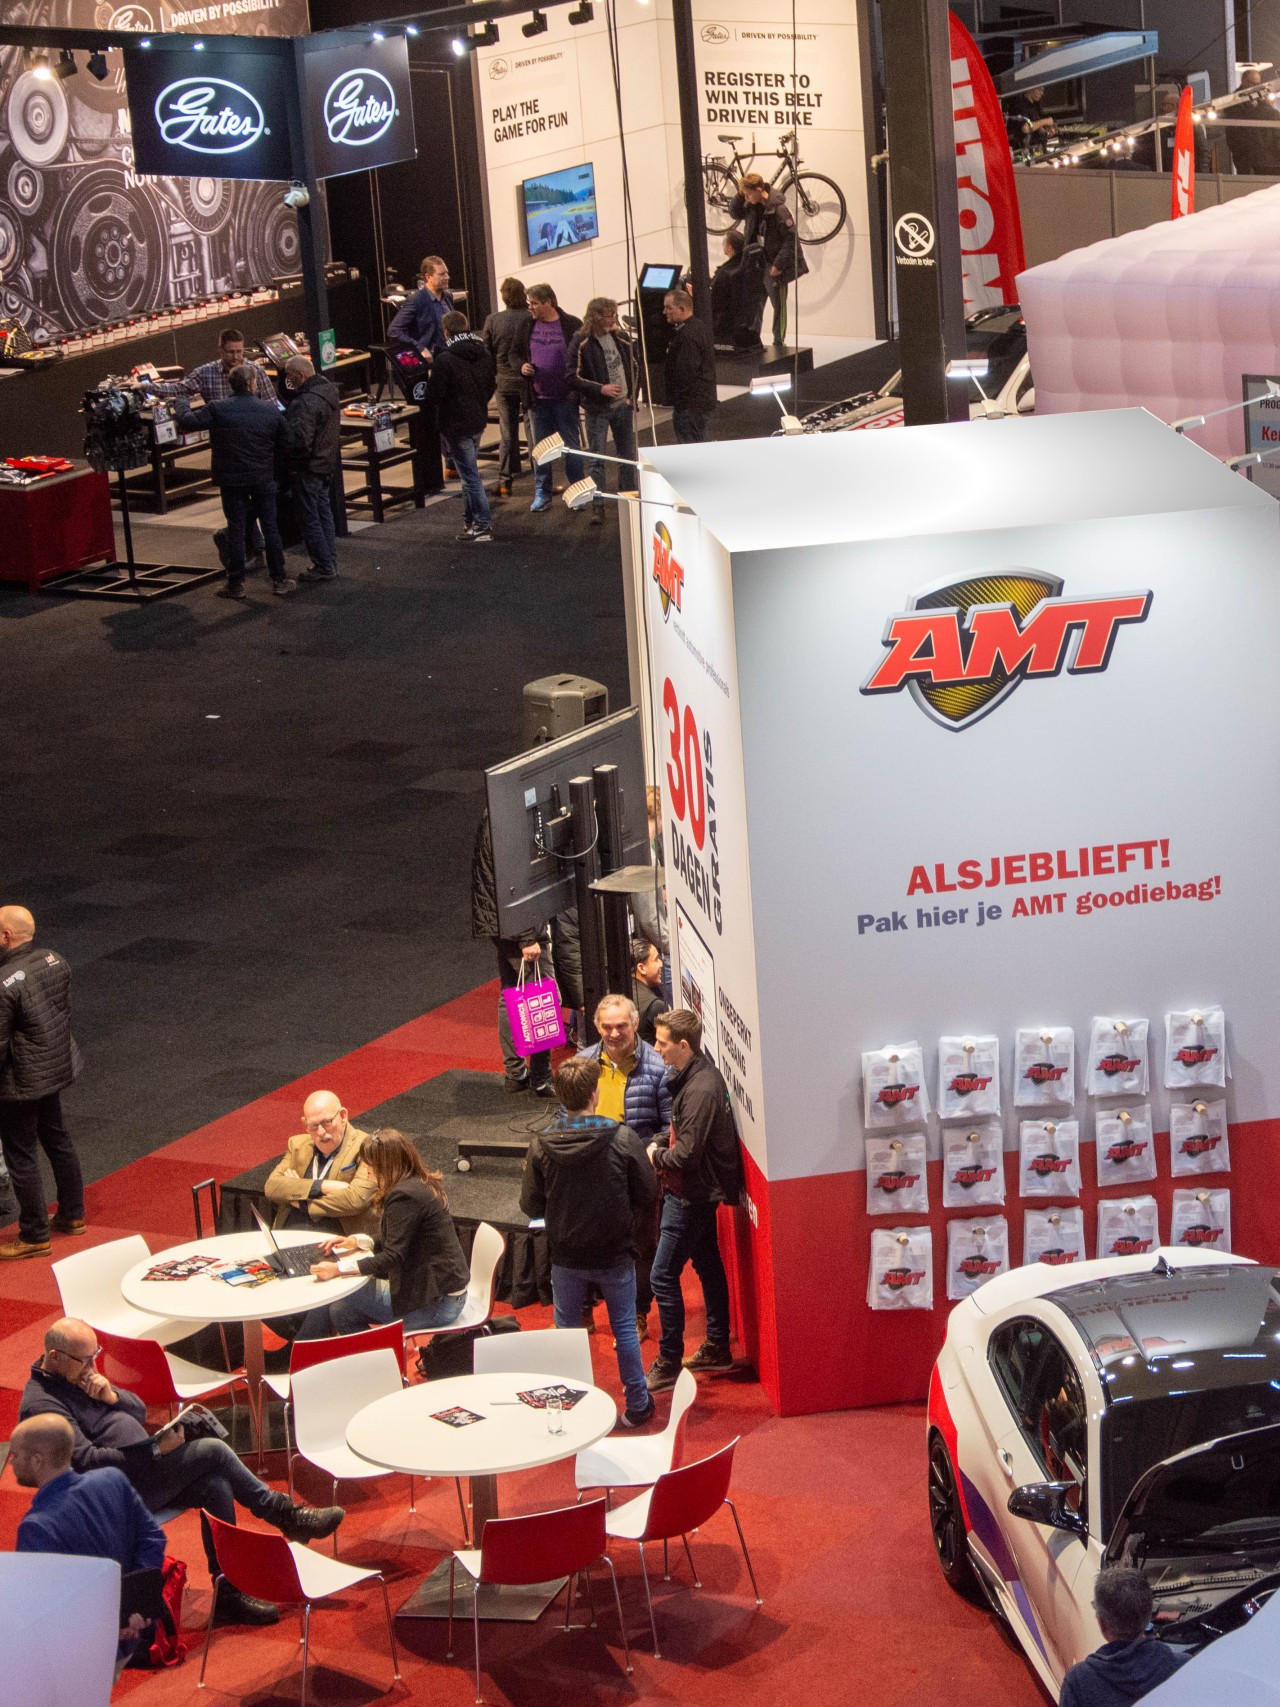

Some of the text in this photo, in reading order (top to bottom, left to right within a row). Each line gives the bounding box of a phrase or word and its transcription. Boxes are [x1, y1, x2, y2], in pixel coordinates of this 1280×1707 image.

[171, 7, 207, 27] DRIVEN
[209, 5, 221, 20] BY
[741, 32, 817, 41] DRIVEN BY POSSIBILITY
[704, 71, 810, 88] REGISTER TO
[705, 89, 823, 107] WIN THIS BELT
[161, 87, 263, 144] Gates
[328, 78, 393, 143] Gates
[492, 99, 539, 124] PLAY THE
[707, 108, 813, 126] DRIVEN BIKE
[494, 112, 568, 143] GAME FOR FUN
[896, 255, 917, 266] Verboden
[652, 532, 684, 613] AMT
[860, 589, 1153, 694] AMT
[663, 677, 705, 851] 30
[703, 728, 723, 937] GRATIS
[670, 819, 712, 922] DAGEN
[907, 838, 1170, 896] ALSJEBLIEFT!
[857, 875, 1222, 934] Pak hier je AMT goodiebag!
[1173, 1047, 1218, 1062] AMT
[1023, 1067, 1068, 1081] AMT
[1095, 1059, 1141, 1073] AMT
[947, 1076, 992, 1091] AMT
[874, 1085, 920, 1103] AMT
[1104, 1142, 1148, 1160] AMT
[1178, 1135, 1221, 1154] AMT
[1027, 1158, 1072, 1173] AMT
[873, 1174, 920, 1189] AMT
[952, 1167, 996, 1184] AMT
[1179, 1227, 1224, 1244] AMT
[1110, 1239, 1153, 1255] AMT
[955, 1260, 1001, 1276] AMT
[879, 1271, 925, 1287] AMT
